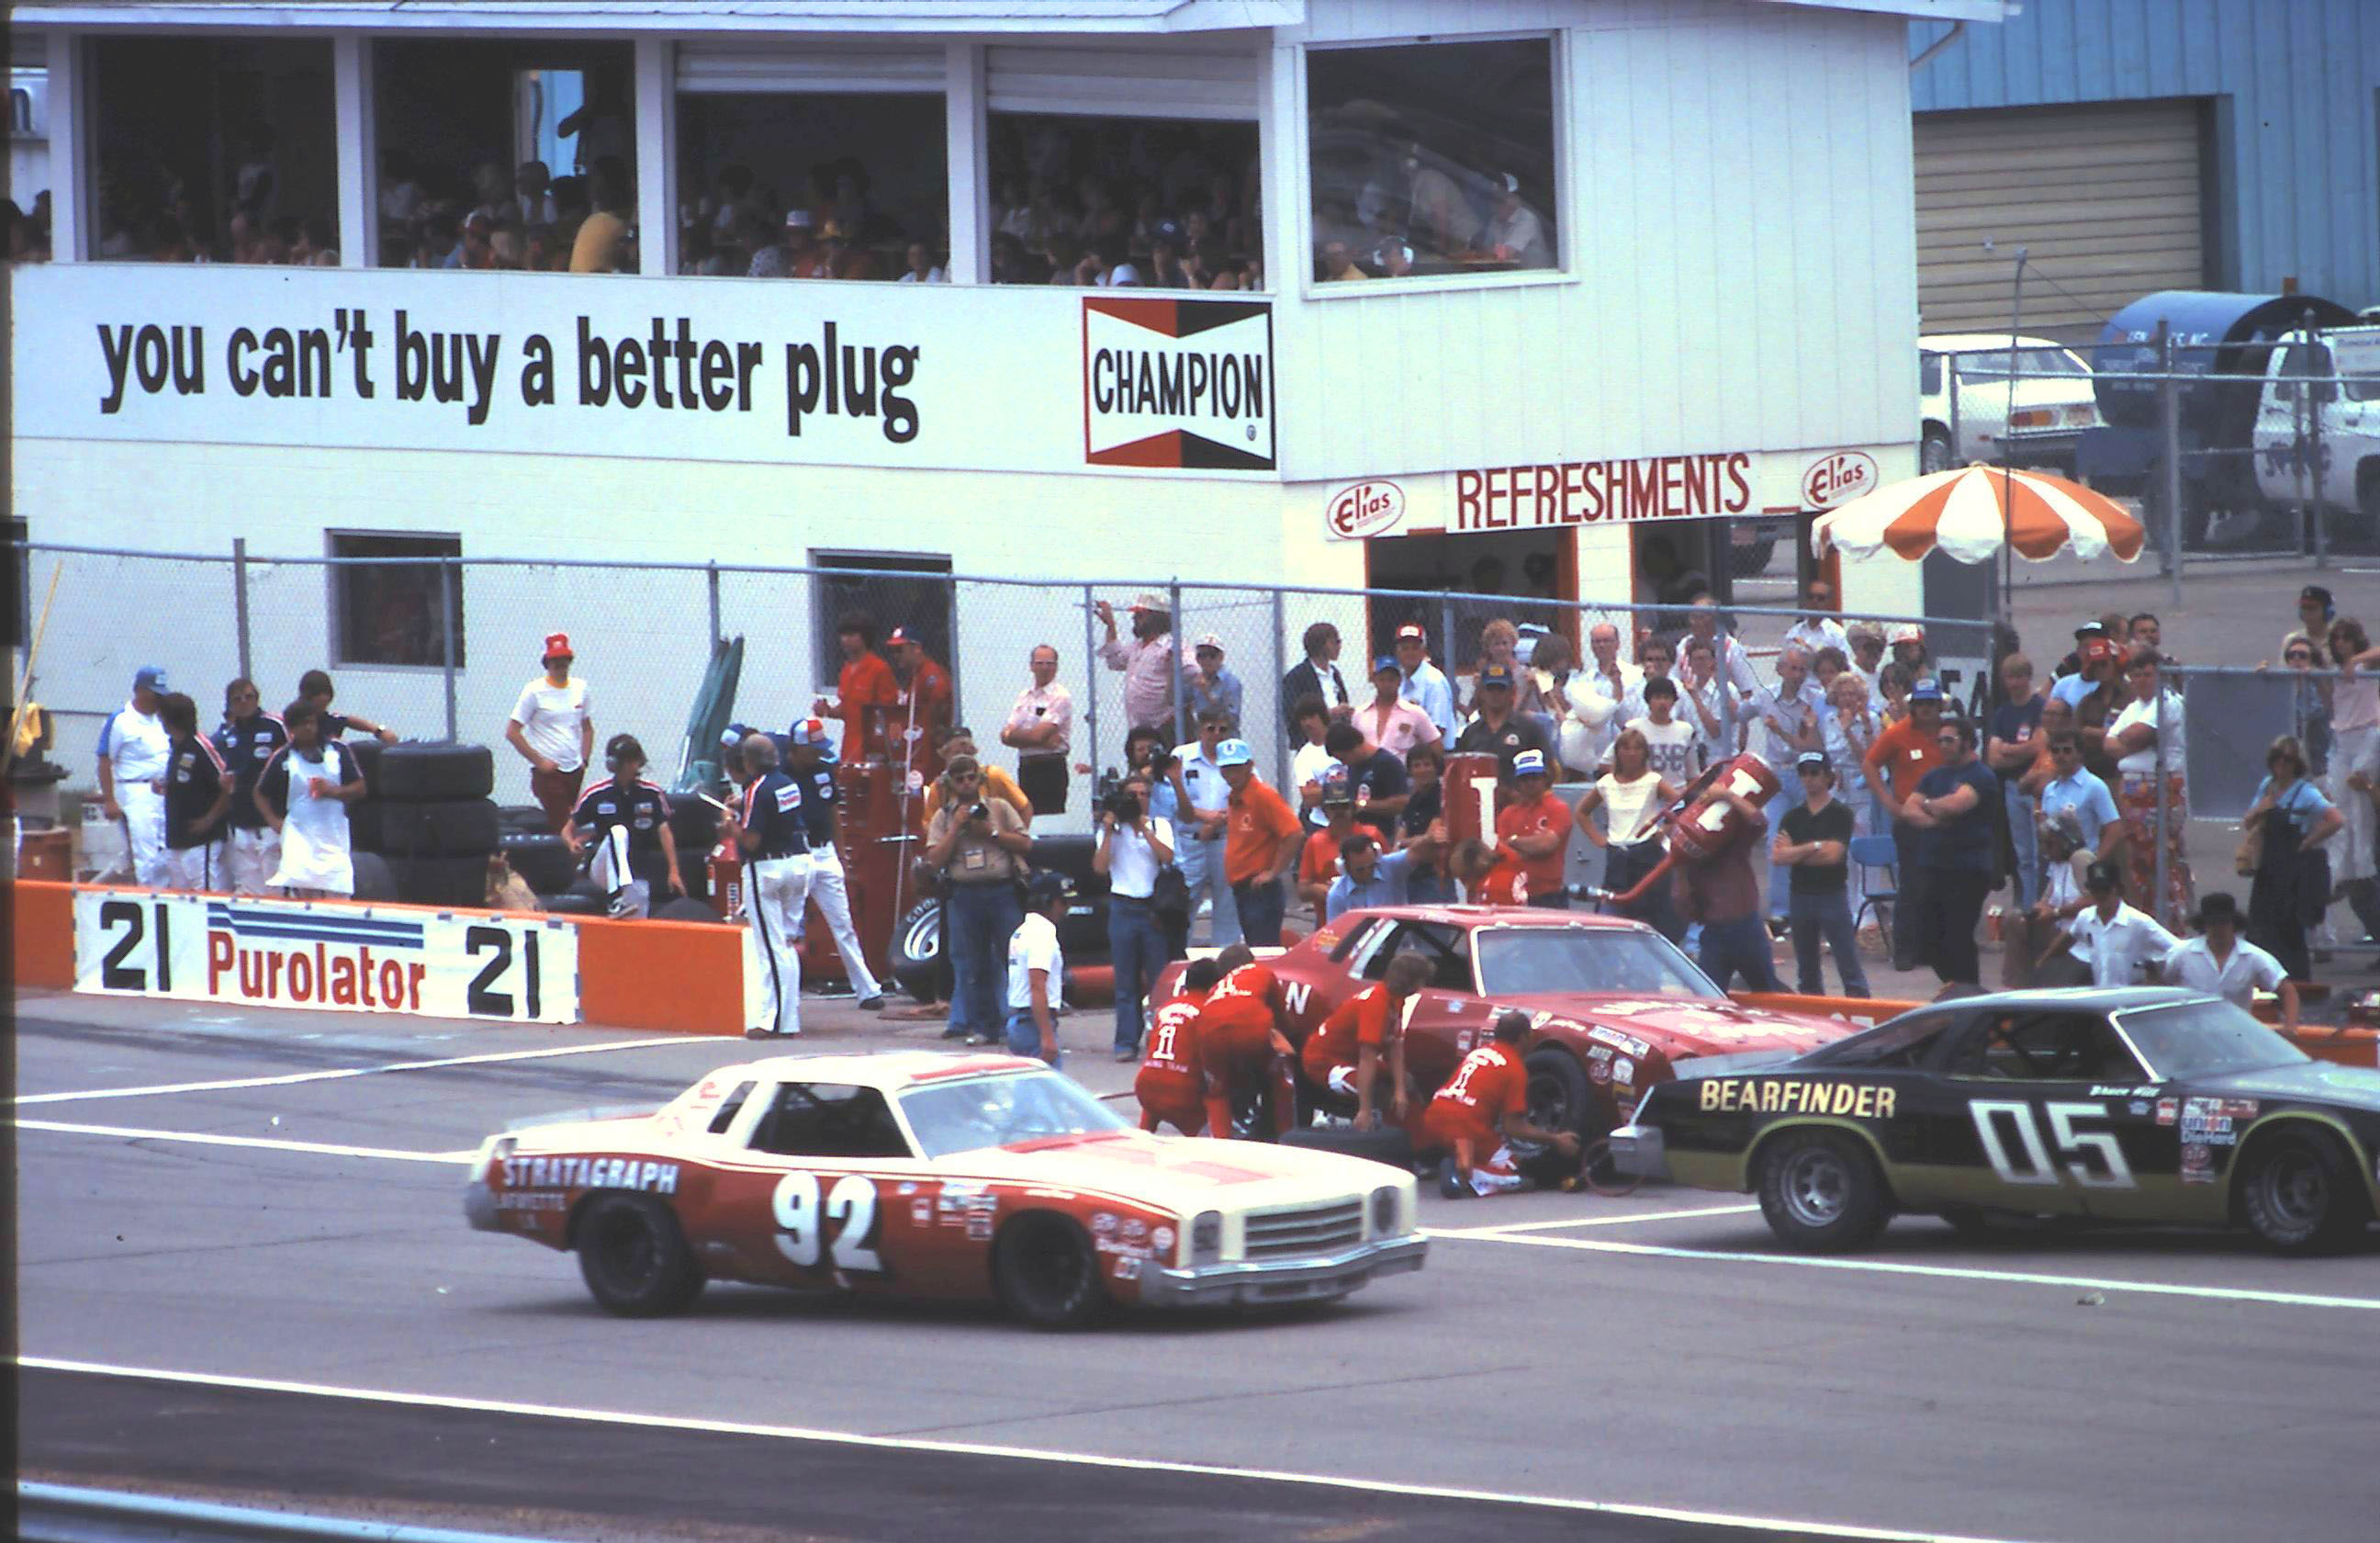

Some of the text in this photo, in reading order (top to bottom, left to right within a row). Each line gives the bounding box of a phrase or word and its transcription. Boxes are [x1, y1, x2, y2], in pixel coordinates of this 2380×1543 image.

[96, 308, 920, 444] you can't buy a better plug
[1093, 348, 1263, 420] CHAMPION
[1455, 452, 1751, 530] REFRESHMENTS
[100, 900, 172, 993] 21
[209, 930, 427, 1011] Purolator
[466, 925, 541, 1019] 21
[1700, 1078, 1897, 1120] BEARFINDER
[1969, 1098, 2139, 1190] 05
[772, 1169, 883, 1272] 92
